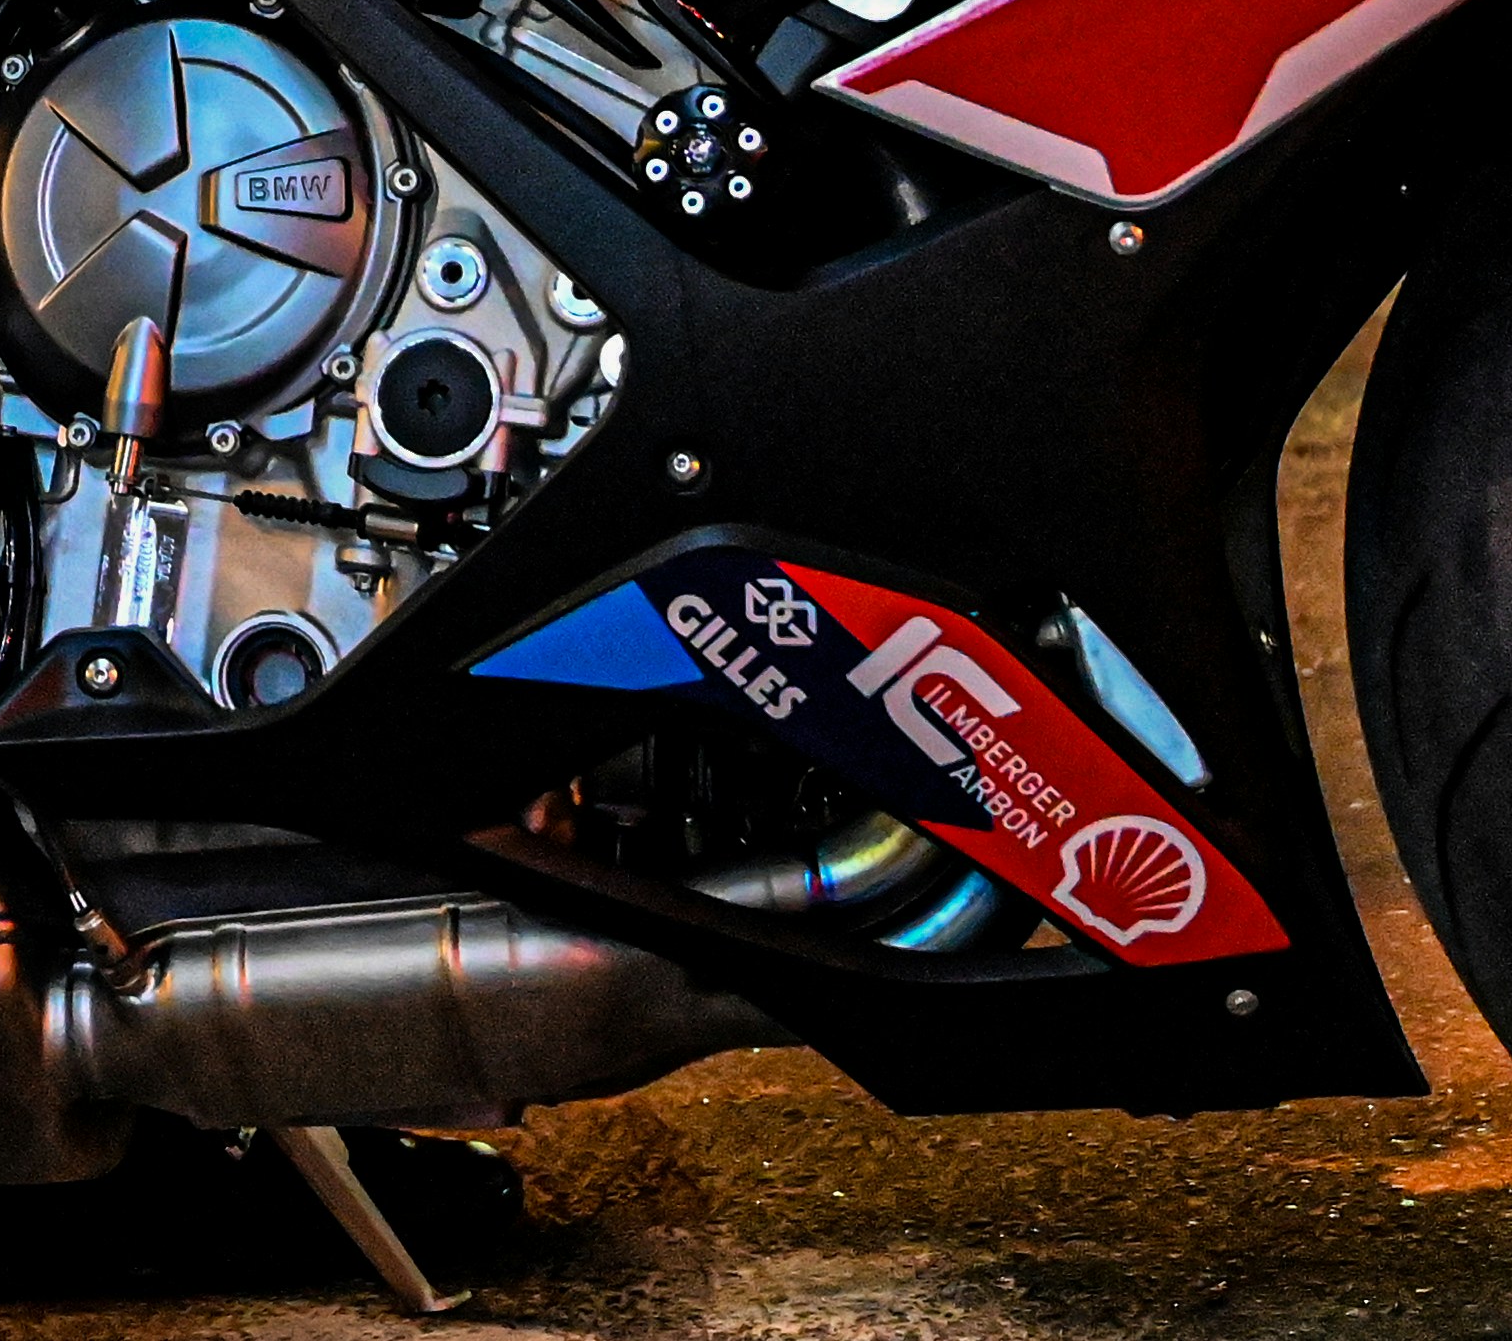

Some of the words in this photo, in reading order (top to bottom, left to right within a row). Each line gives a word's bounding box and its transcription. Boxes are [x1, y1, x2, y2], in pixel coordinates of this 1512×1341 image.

[248, 174, 332, 203] BMW
[666, 593, 808, 719] GILLES
[922, 682, 1076, 828] ILMBERGER
[948, 763, 1049, 850] ARBON
